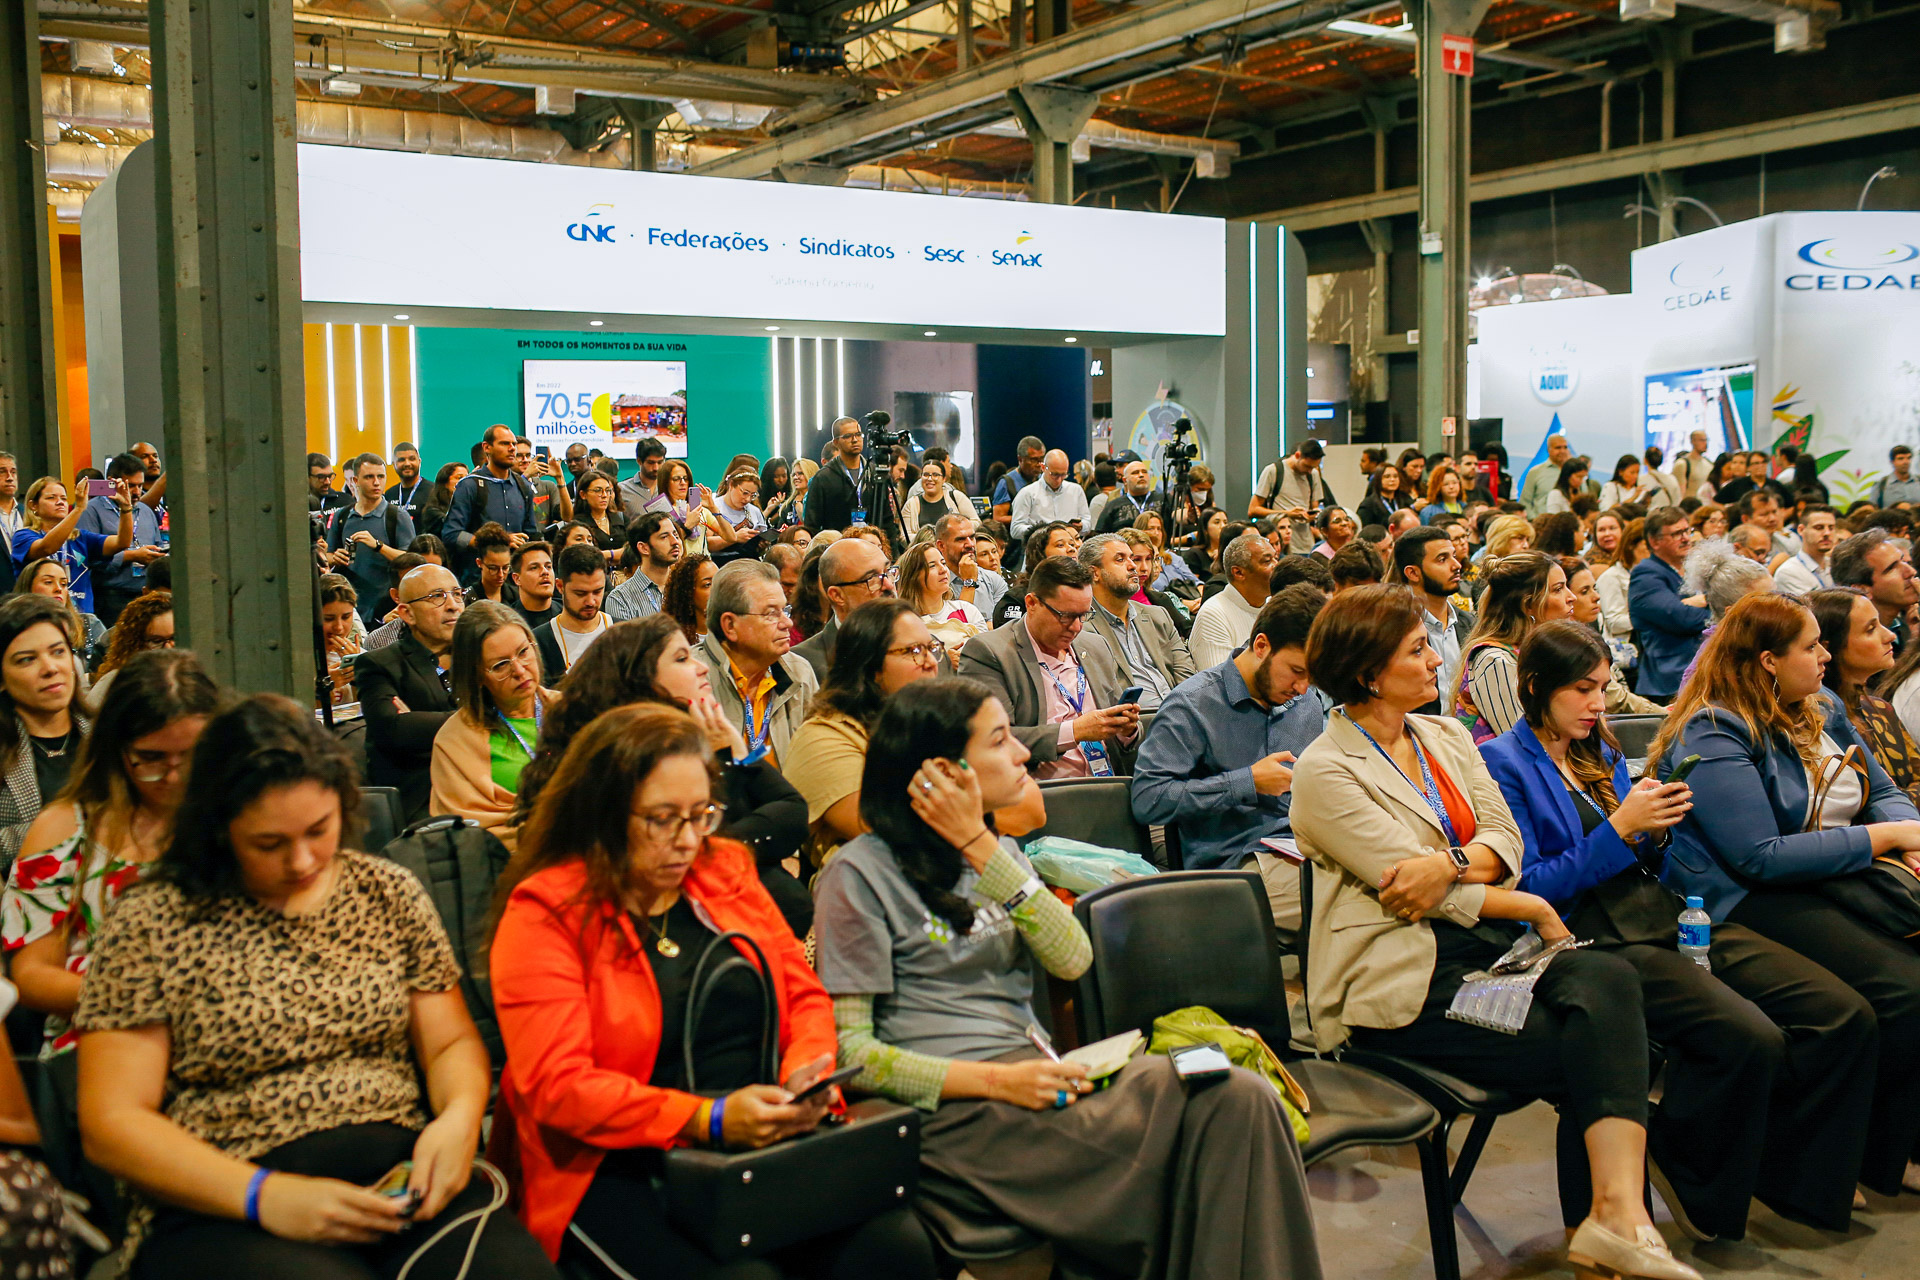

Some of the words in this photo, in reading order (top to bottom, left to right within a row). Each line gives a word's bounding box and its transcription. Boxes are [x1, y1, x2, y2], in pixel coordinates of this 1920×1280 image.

[566, 223, 615, 243] CNC
[648, 227, 769, 252] Federações
[799, 237, 895, 259] Sindicatos
[924, 245, 965, 263] Sesc
[992, 249, 1043, 268] Senac
[1664, 285, 1732, 311] CEDAE
[517, 339, 531, 349] EM
[533, 340, 564, 349] TODOS
[566, 341, 579, 349] OS
[581, 341, 631, 350] MOMENTOS
[633, 342, 645, 350] DA
[647, 343, 665, 351] SUA
[666, 343, 687, 351] VIDA
[535, 392, 592, 419] 70,5
[536, 420, 597, 435] milhões
